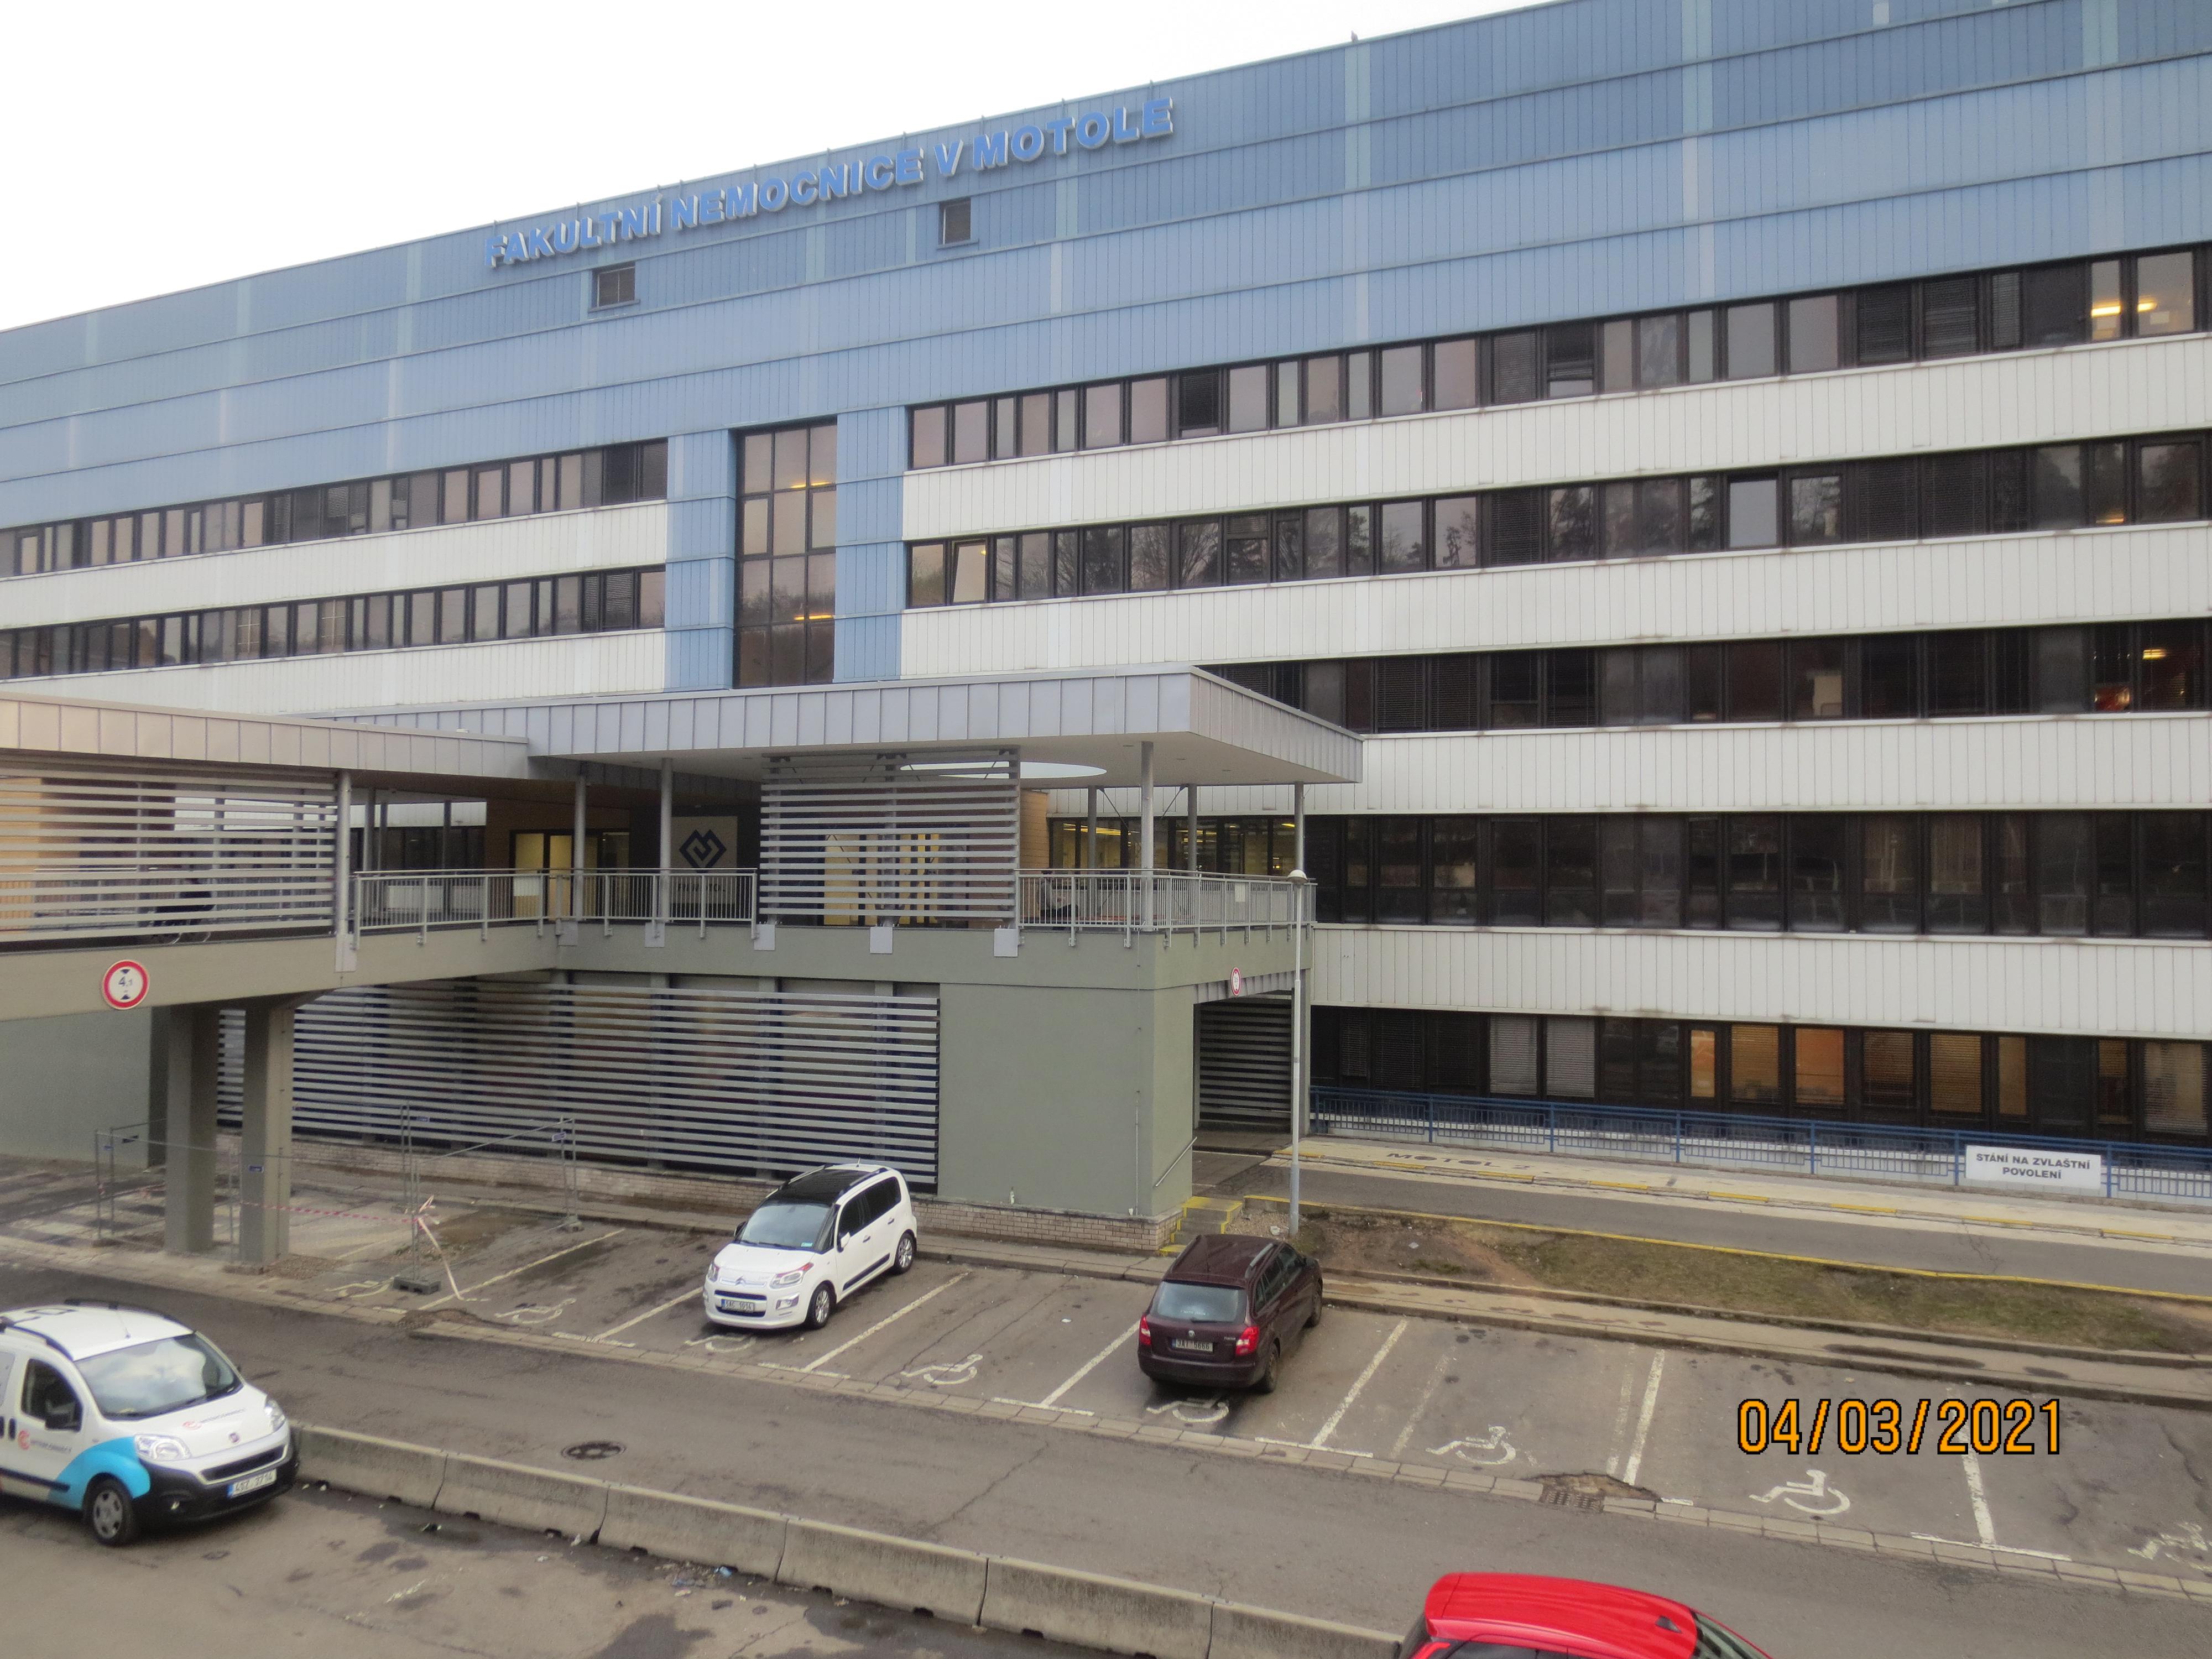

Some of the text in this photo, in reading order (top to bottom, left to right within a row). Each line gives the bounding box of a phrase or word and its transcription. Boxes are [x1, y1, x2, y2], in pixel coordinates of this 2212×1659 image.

[484, 97, 1173, 268] FAKULTNÍ NEMOCNICE V MOTOLE
[1386, 1153, 1500, 1167] MOTOL
[1976, 1152, 2090, 1170] STÁNÍ NA ZVLAŠTNÍ
[2002, 1167, 2062, 1180] POVOLENÍ
